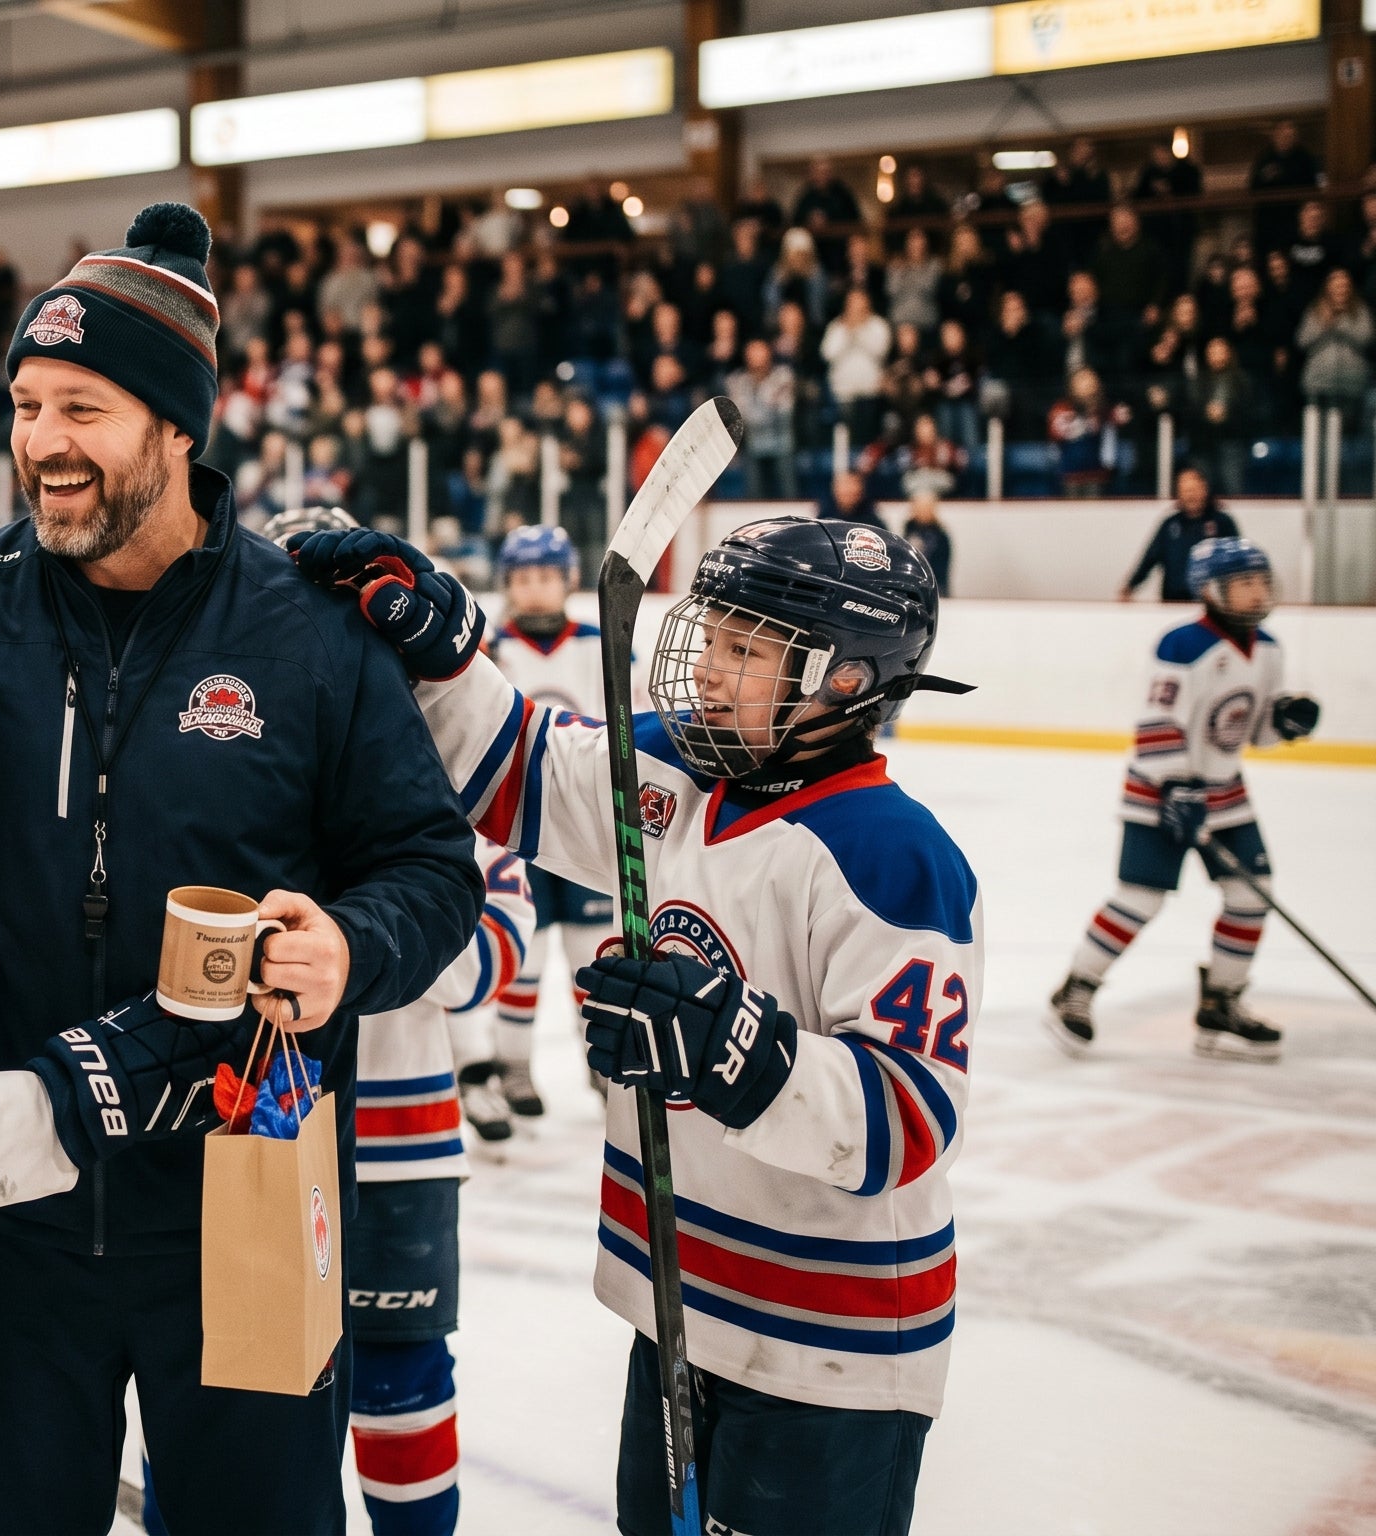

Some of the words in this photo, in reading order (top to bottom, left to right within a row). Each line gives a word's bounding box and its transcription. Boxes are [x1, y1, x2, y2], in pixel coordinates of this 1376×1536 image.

[870, 957, 969, 1075] 42
[58, 1027, 128, 1136] BAUE
[348, 1288, 438, 1309] CCM
